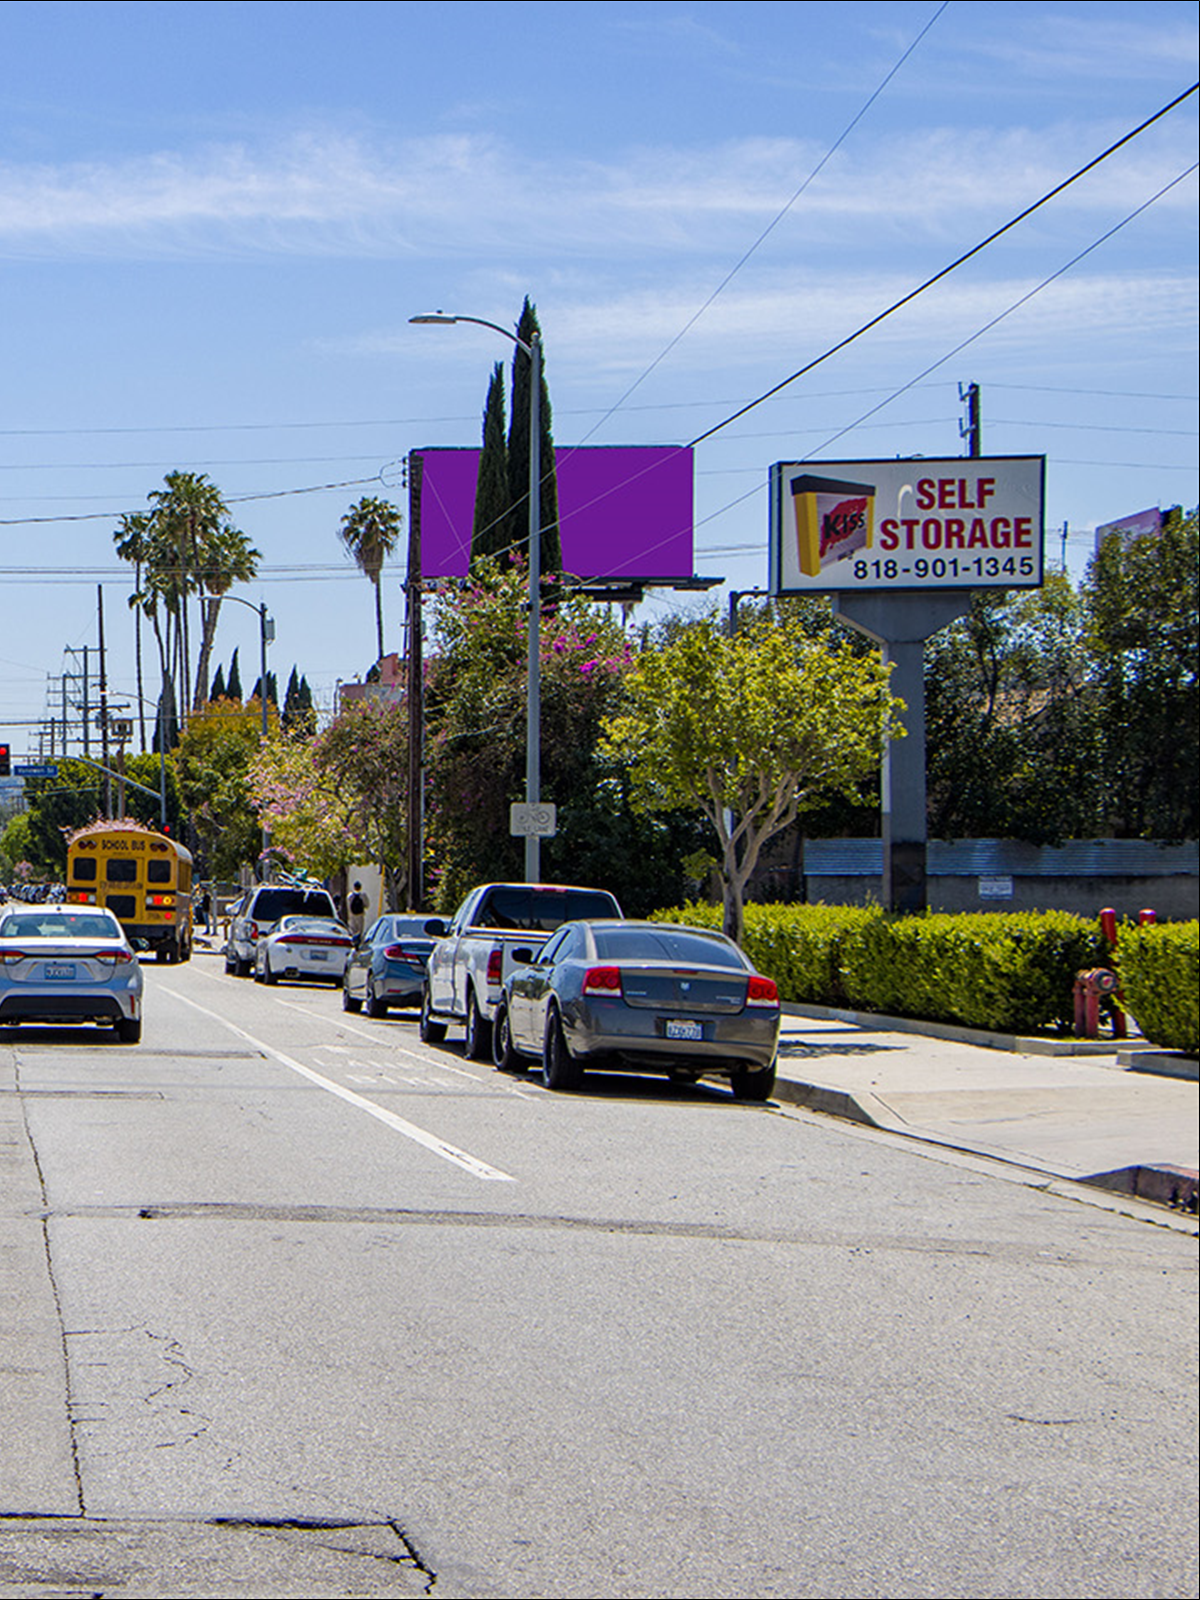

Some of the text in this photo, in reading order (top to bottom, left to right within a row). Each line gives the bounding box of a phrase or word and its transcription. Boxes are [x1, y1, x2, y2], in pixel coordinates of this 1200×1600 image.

[915, 477, 996, 511] SELF
[823, 512, 866, 540] KISS
[879, 517, 1033, 551] STORAGE
[853, 556, 1035, 580] 818-901-1345
[101, 838, 146, 852] SCHOOL BUS
